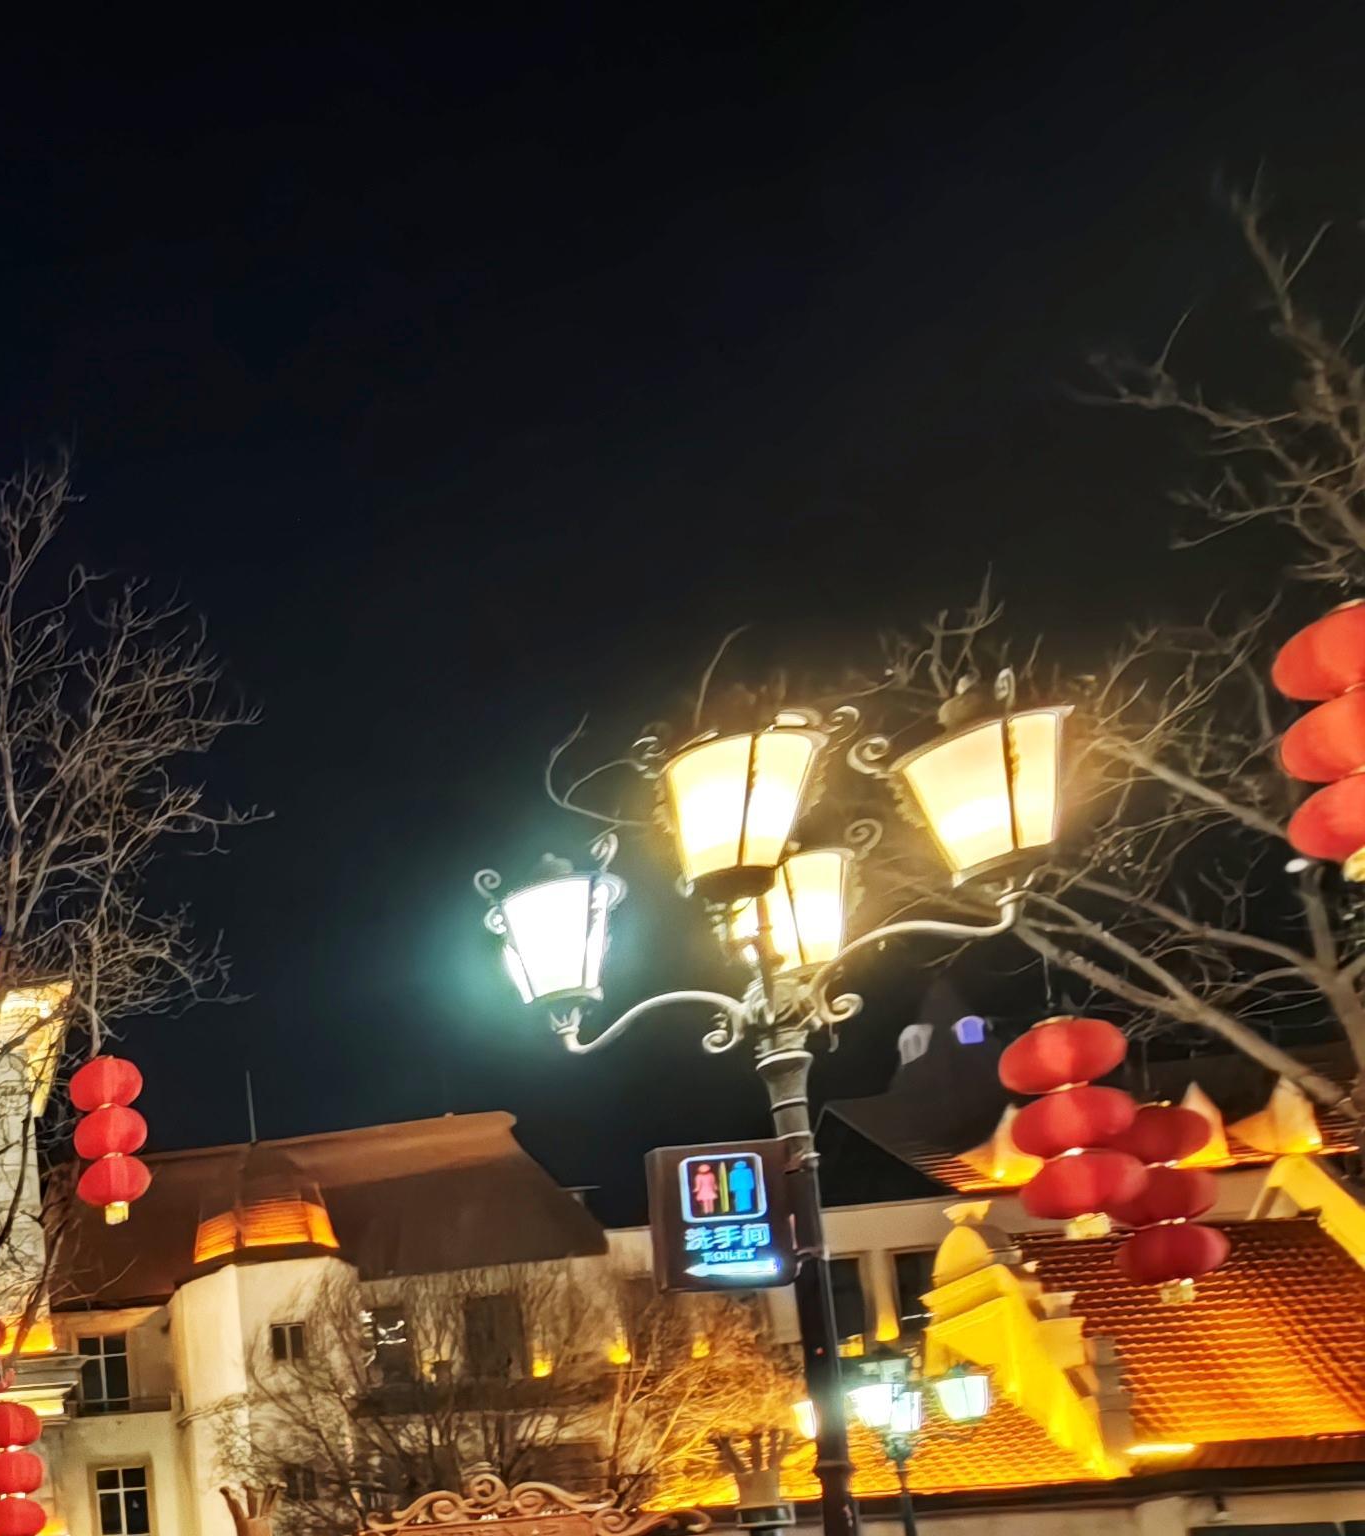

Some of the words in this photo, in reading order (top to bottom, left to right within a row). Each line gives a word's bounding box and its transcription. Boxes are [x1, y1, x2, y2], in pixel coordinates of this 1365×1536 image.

[685, 1223, 771, 1250] 洗手间
[701, 1247, 756, 1262] TOILET
